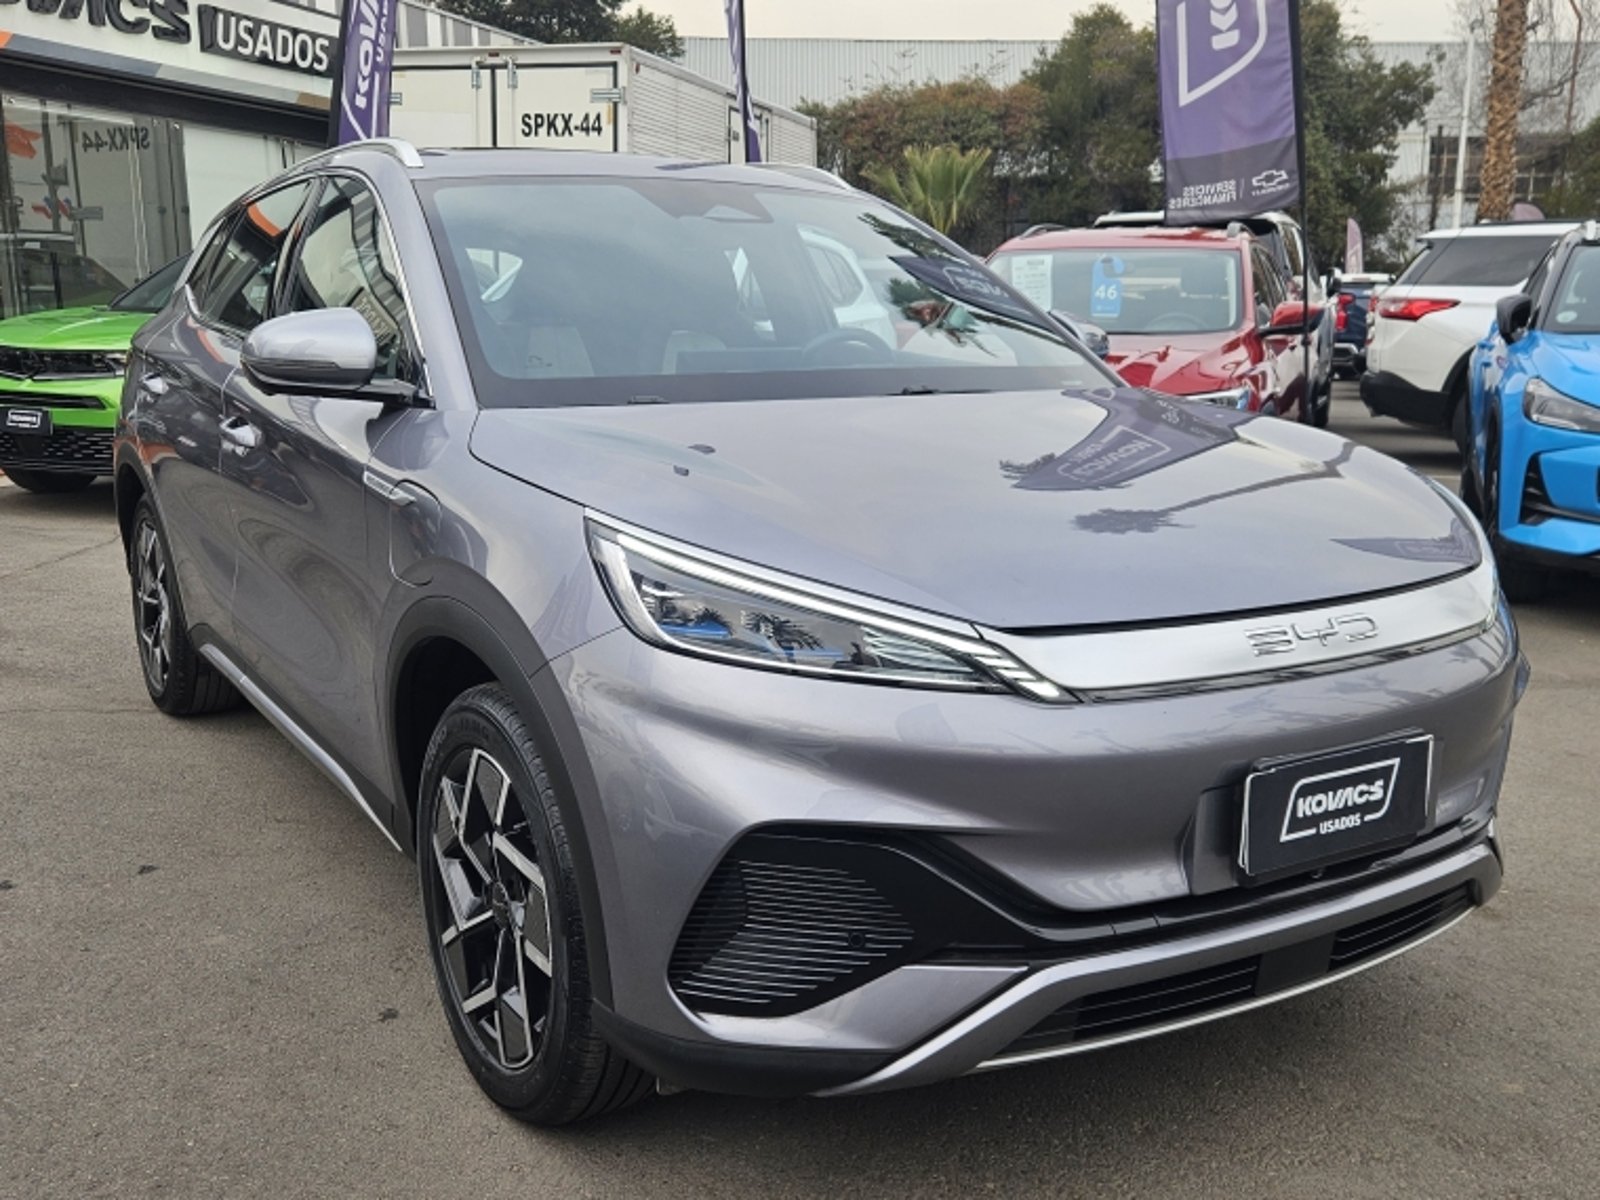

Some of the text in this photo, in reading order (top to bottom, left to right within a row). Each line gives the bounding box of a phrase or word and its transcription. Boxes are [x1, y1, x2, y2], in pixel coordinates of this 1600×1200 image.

[217, 12, 329, 71] USADOS
[521, 112, 602, 137] SPKX-44
[1095, 284, 1118, 300] 46
[1244, 613, 1378, 657] BYD
[1297, 779, 1384, 818] KOVACS
[1320, 813, 1361, 834] USADOS
